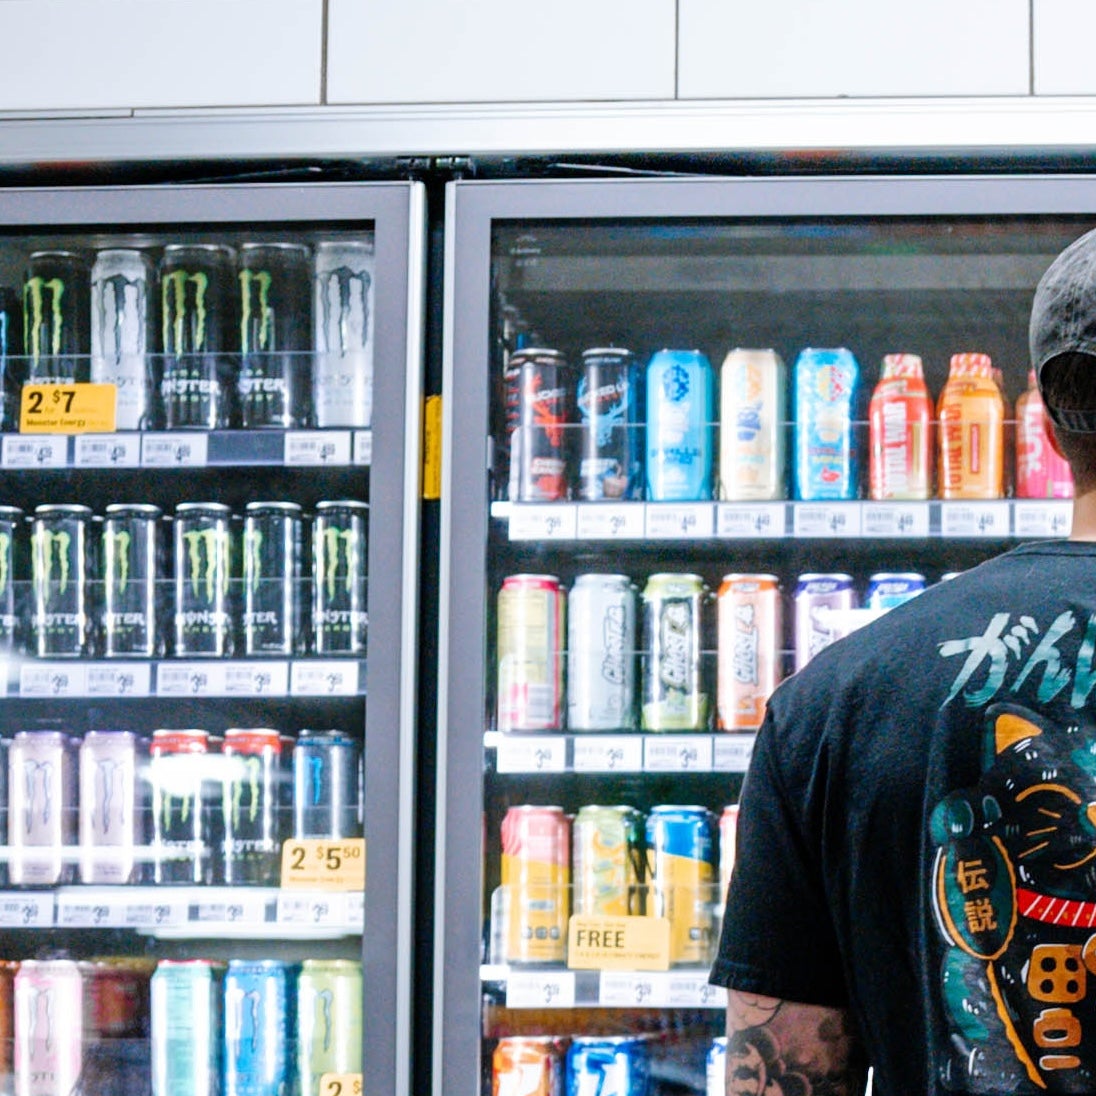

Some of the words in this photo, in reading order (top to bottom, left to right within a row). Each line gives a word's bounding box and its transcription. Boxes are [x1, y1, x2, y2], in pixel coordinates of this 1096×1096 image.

[28, 392, 43, 413] 2
[53, 390, 76, 413] $7
[291, 847, 306, 870] 2
[956, 858, 998, 935] 伝説
[577, 930, 625, 948] FREE
